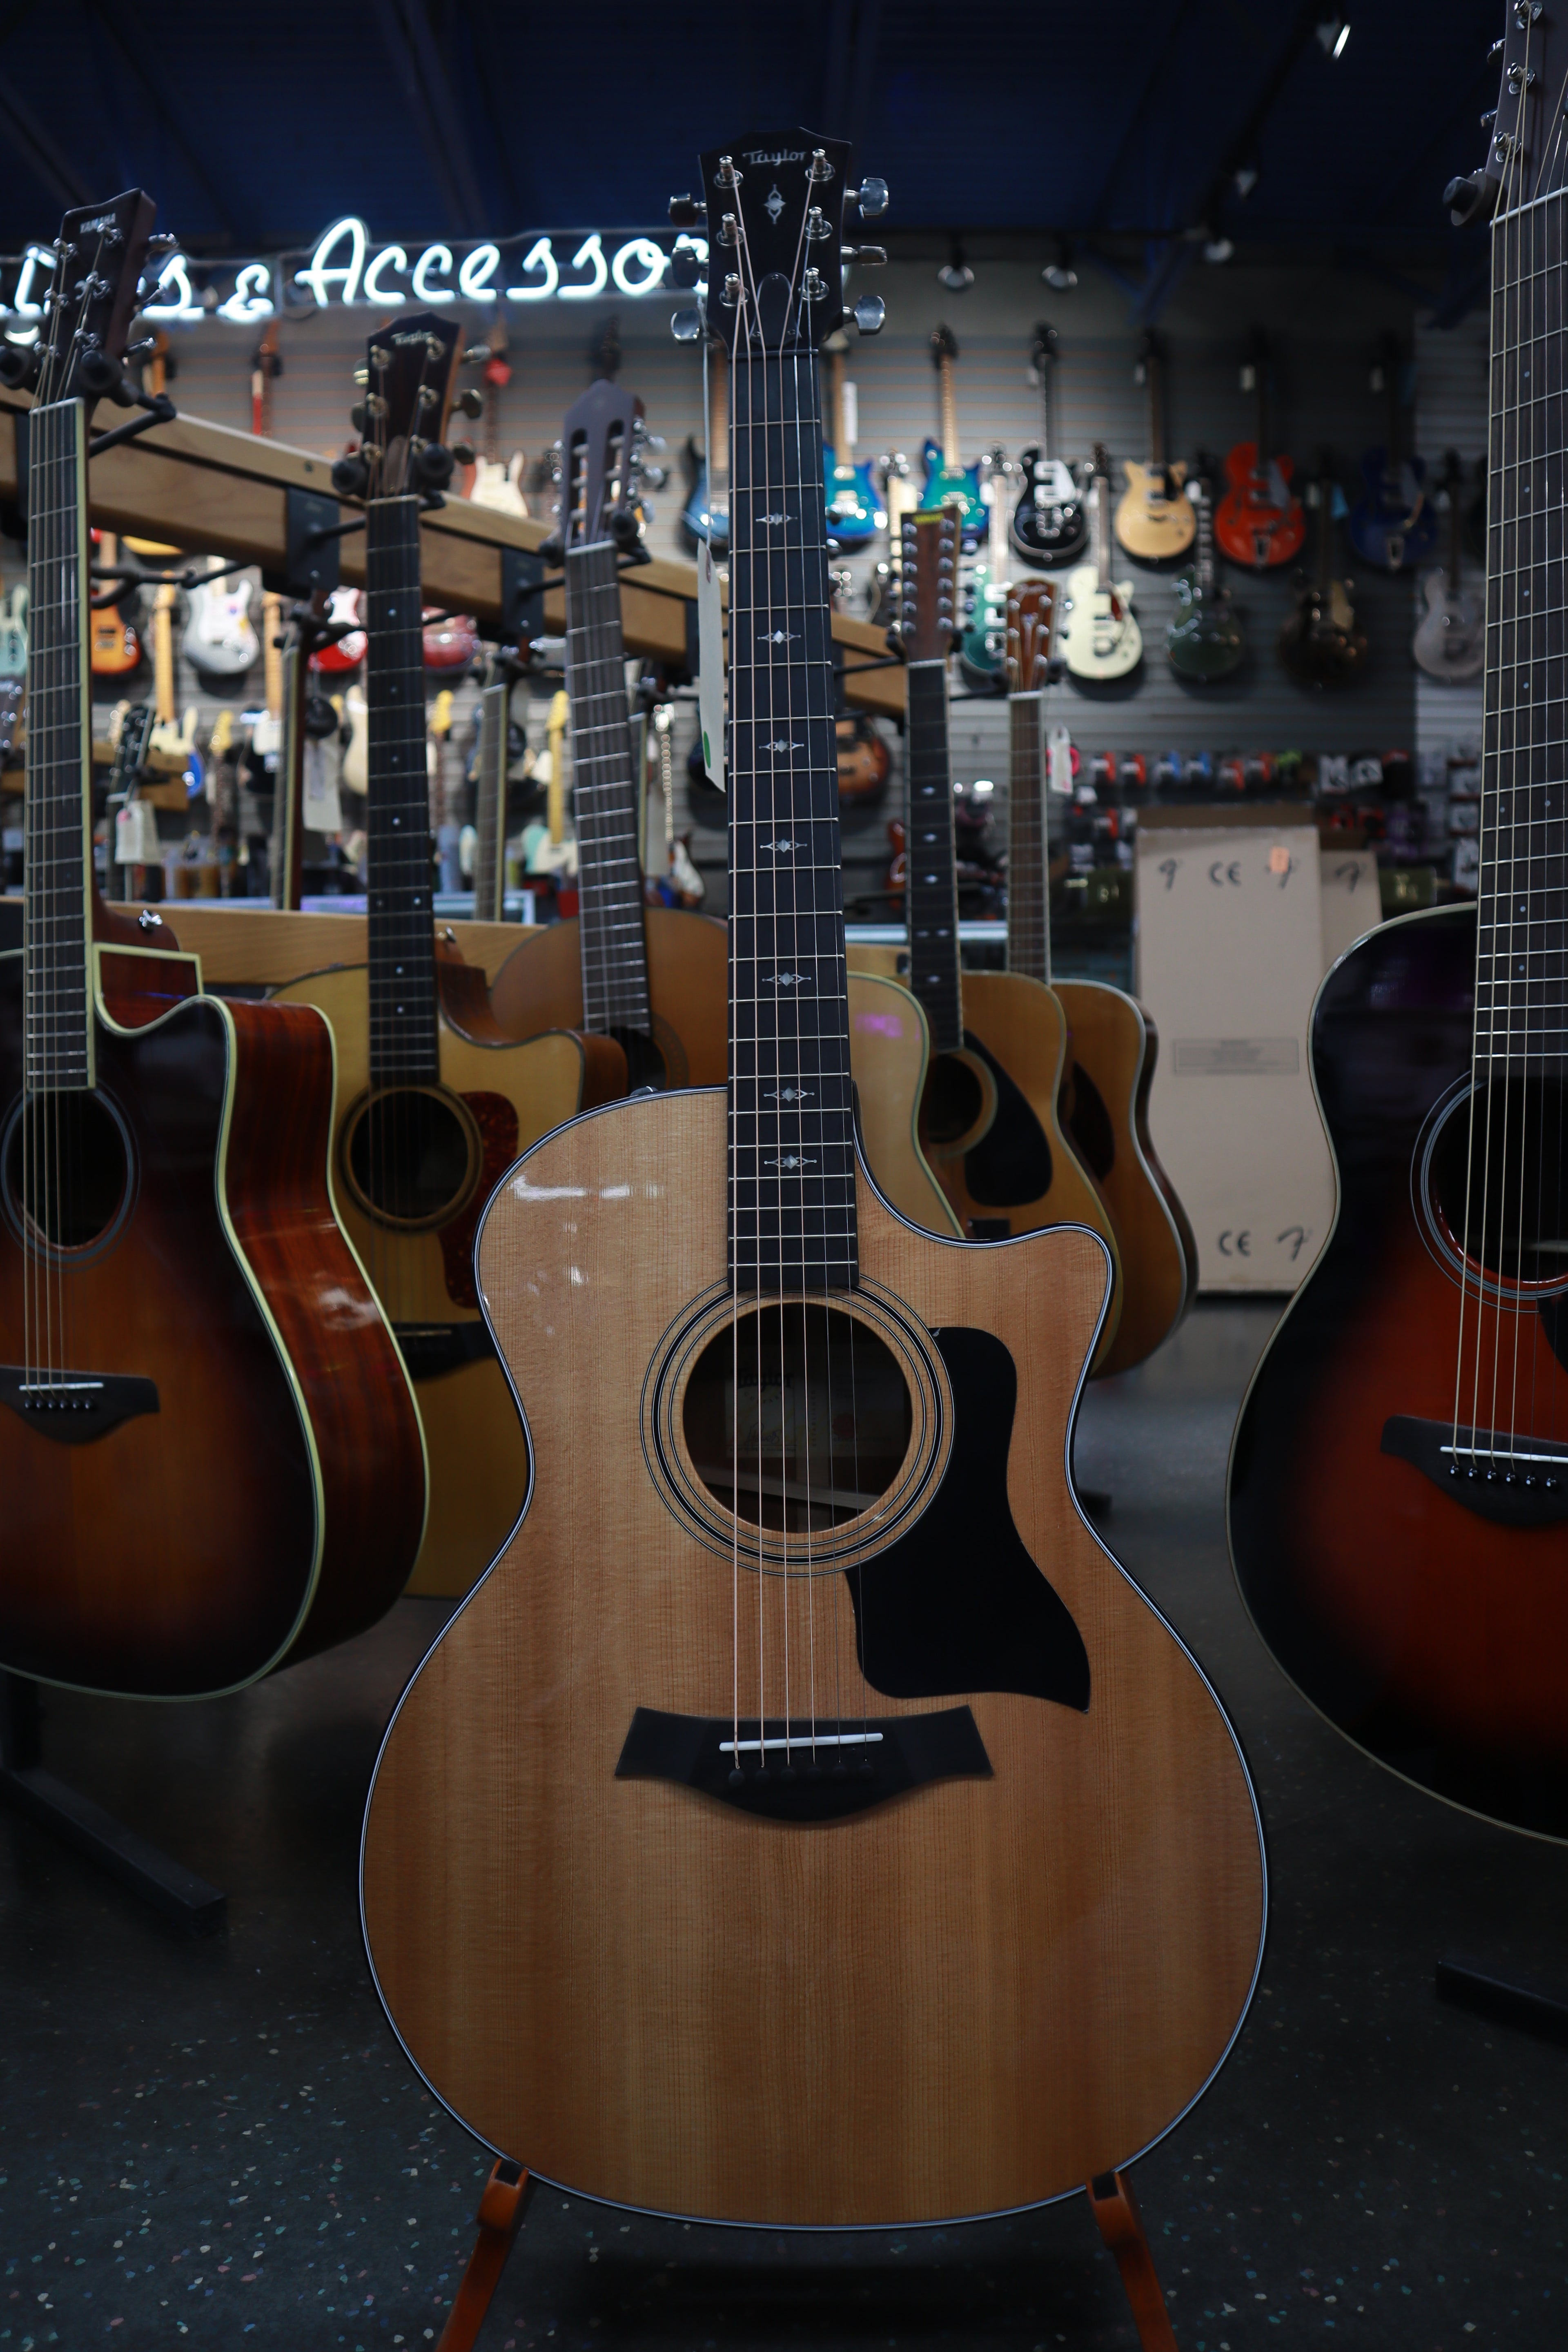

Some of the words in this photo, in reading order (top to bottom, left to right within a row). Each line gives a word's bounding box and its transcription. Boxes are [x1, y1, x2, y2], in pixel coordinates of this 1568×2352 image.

[742, 148, 807, 166] Taylor
[1209, 861, 1242, 888] CE
[1217, 1230, 1252, 1257] CE
[730, 1365, 795, 1392] Taylor
